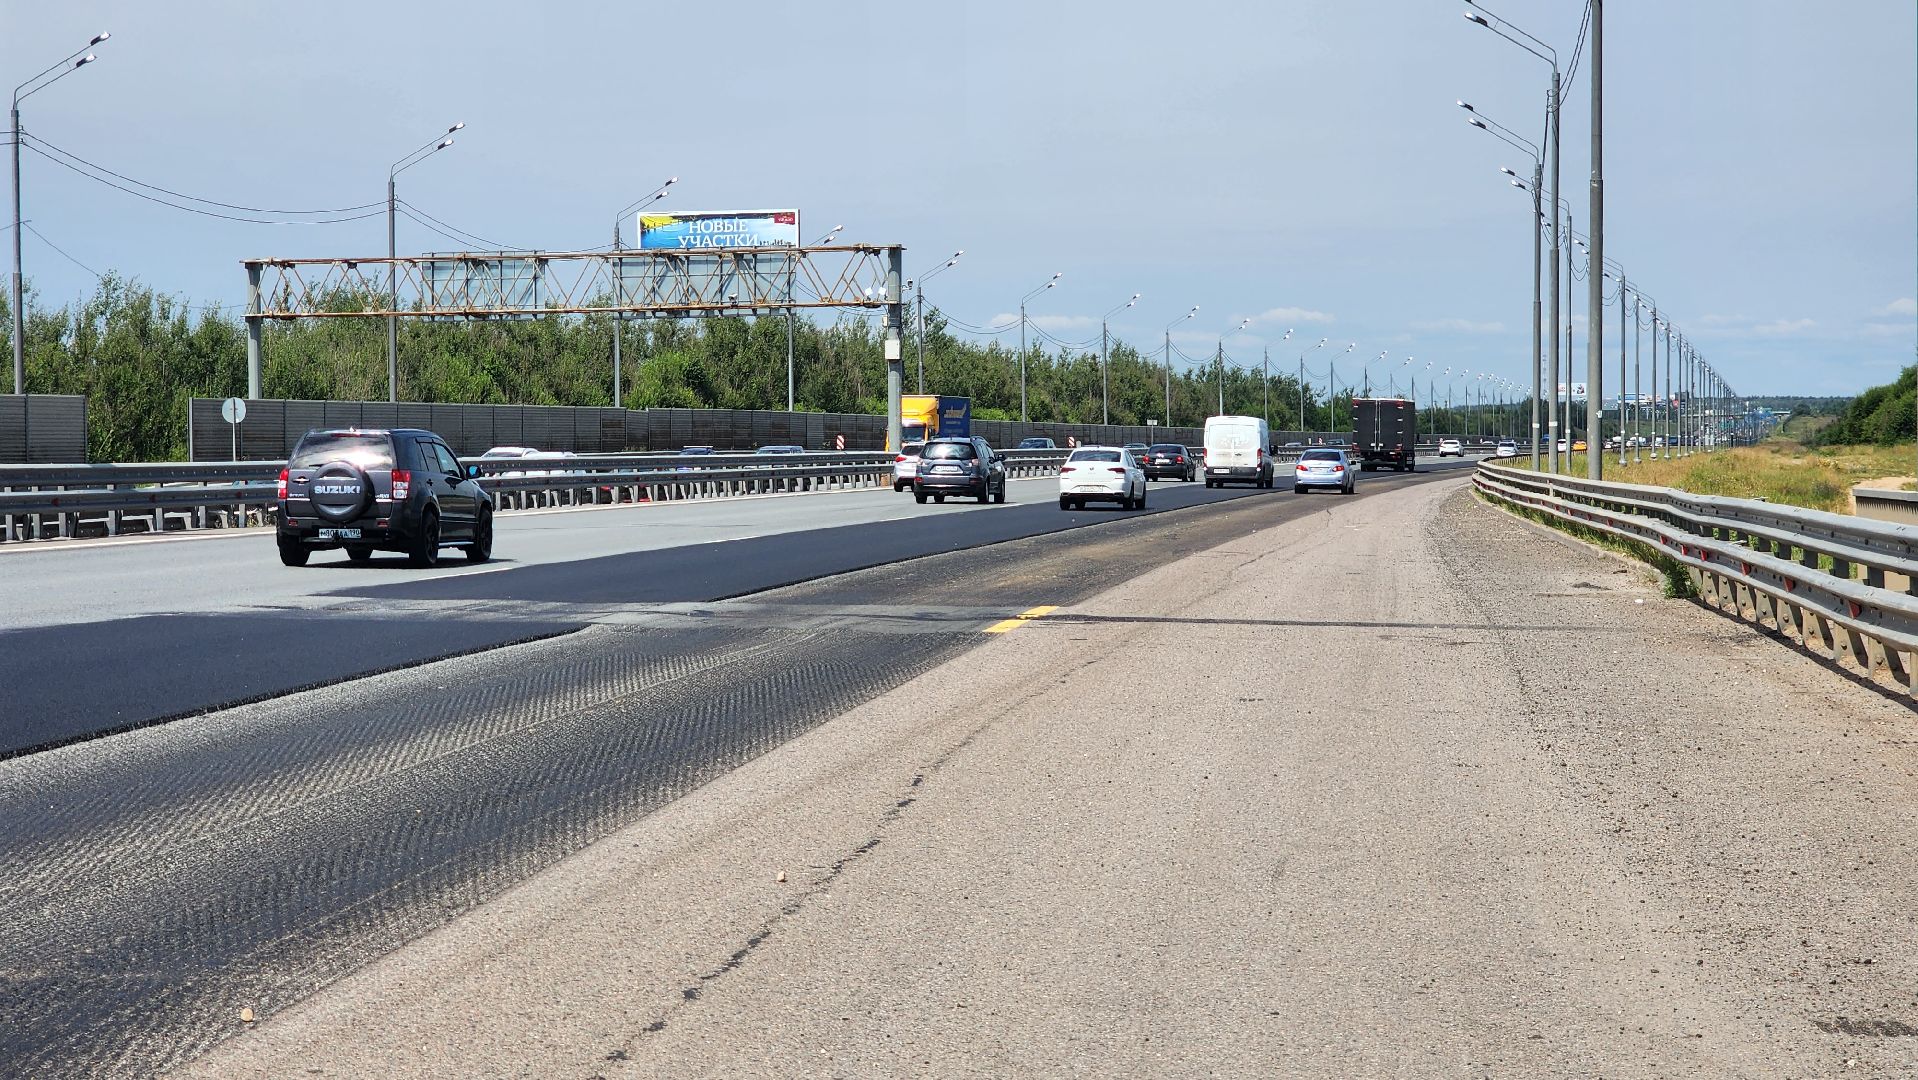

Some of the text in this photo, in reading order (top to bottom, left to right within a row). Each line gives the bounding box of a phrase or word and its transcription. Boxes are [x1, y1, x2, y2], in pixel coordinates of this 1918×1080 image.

[688, 219, 748, 234] НОВЫЕ
[678, 234, 759, 248] УЧАСТКИ
[314, 485, 361, 494] SUZUKI
